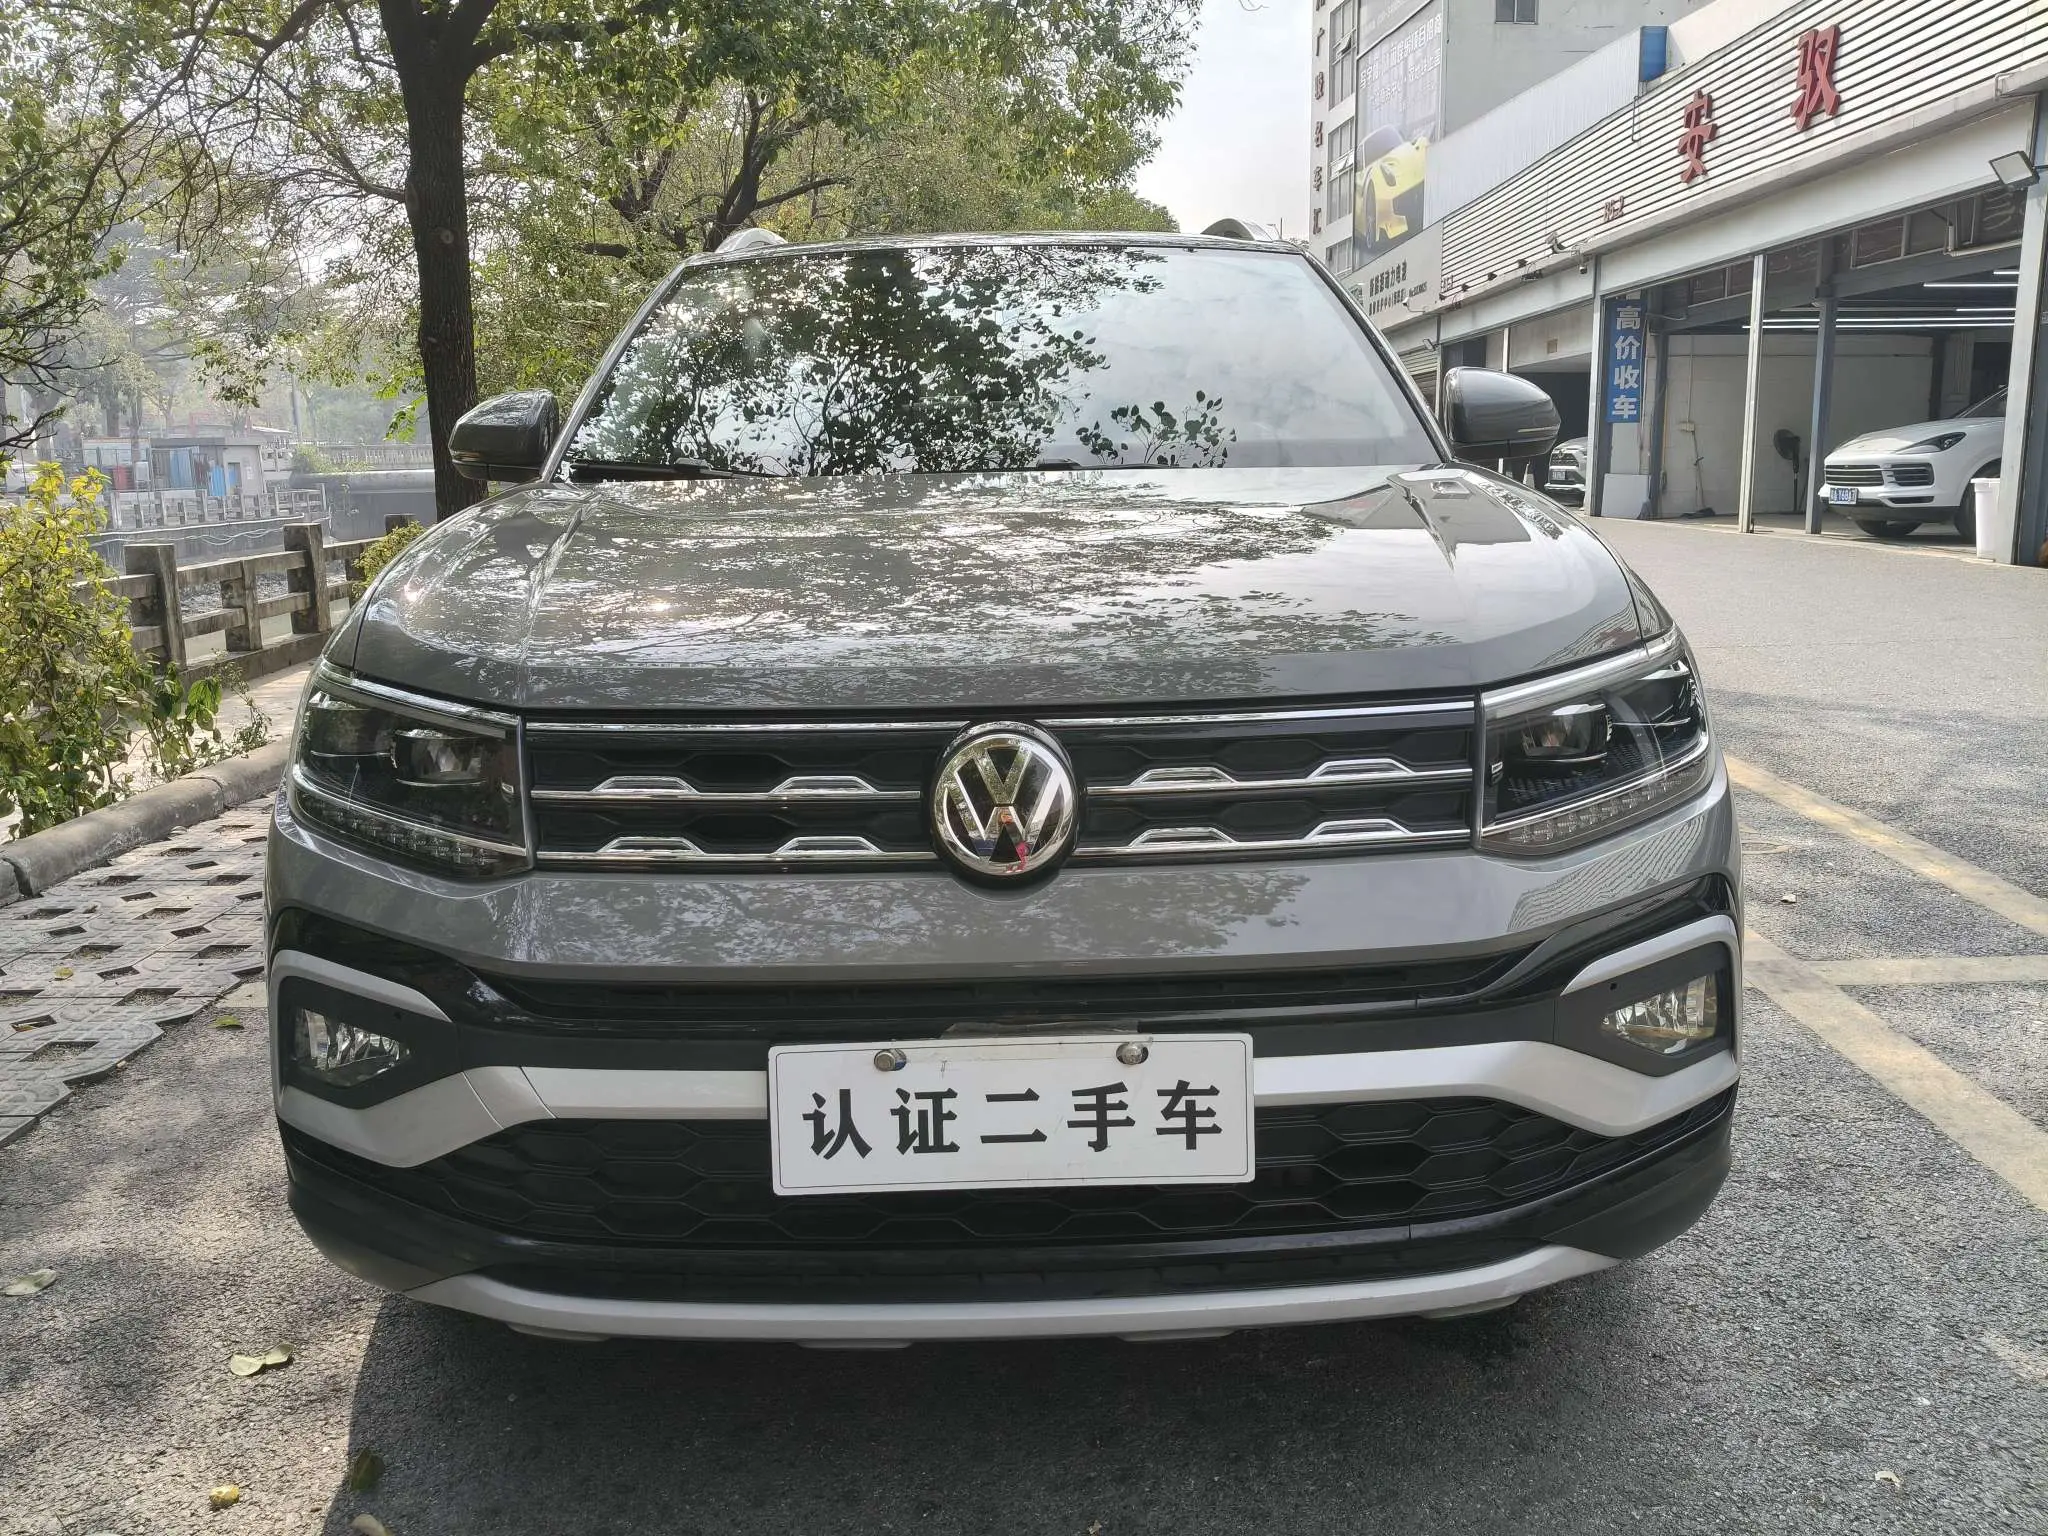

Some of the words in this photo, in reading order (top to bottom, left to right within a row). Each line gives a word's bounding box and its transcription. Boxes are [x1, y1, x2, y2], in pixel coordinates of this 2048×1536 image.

[1612, 306, 1641, 419] 高价收车
[802, 1079, 1222, 1160] 认证二手车
